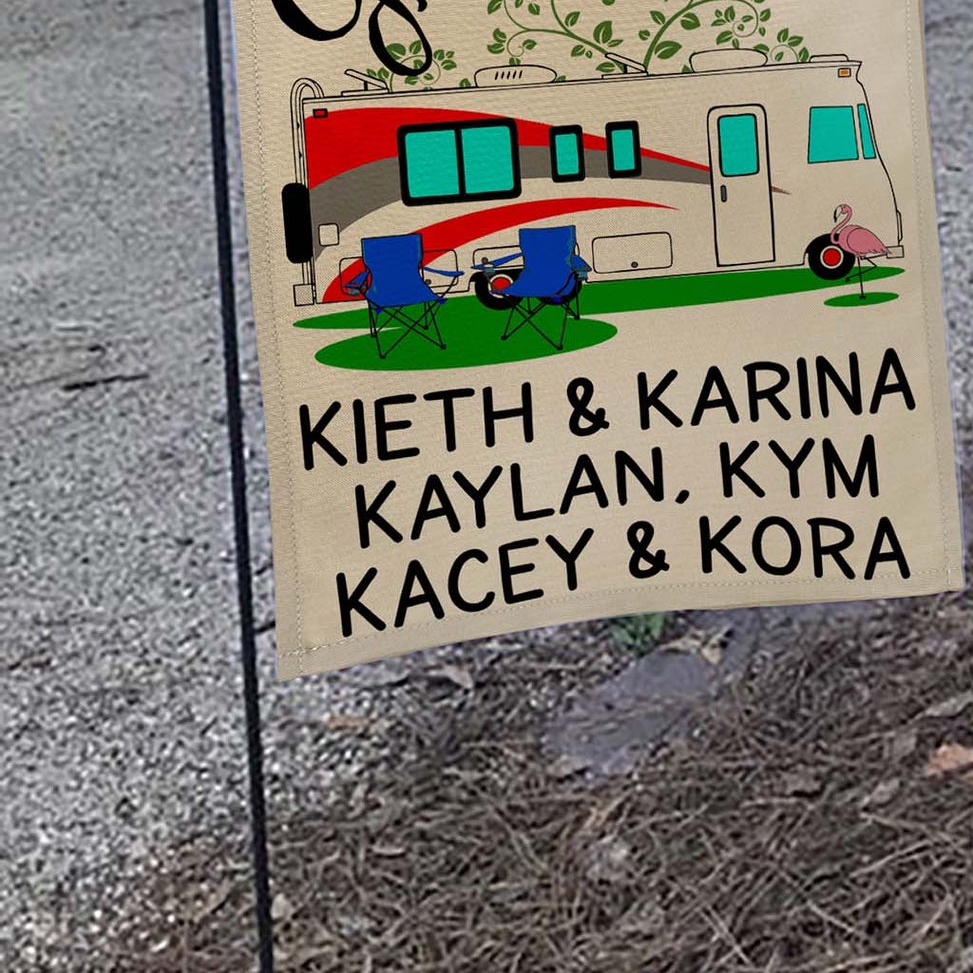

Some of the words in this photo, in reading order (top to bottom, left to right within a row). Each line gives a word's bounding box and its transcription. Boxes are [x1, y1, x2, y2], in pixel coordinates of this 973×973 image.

[300, 381, 535, 470] KIETH
[565, 377, 609, 437] &
[637, 347, 916, 430] KARINA
[719, 434, 880, 499] KYM
[336, 527, 594, 637] KACEY
[626, 520, 670, 580] &
[699, 514, 911, 580] KORA
